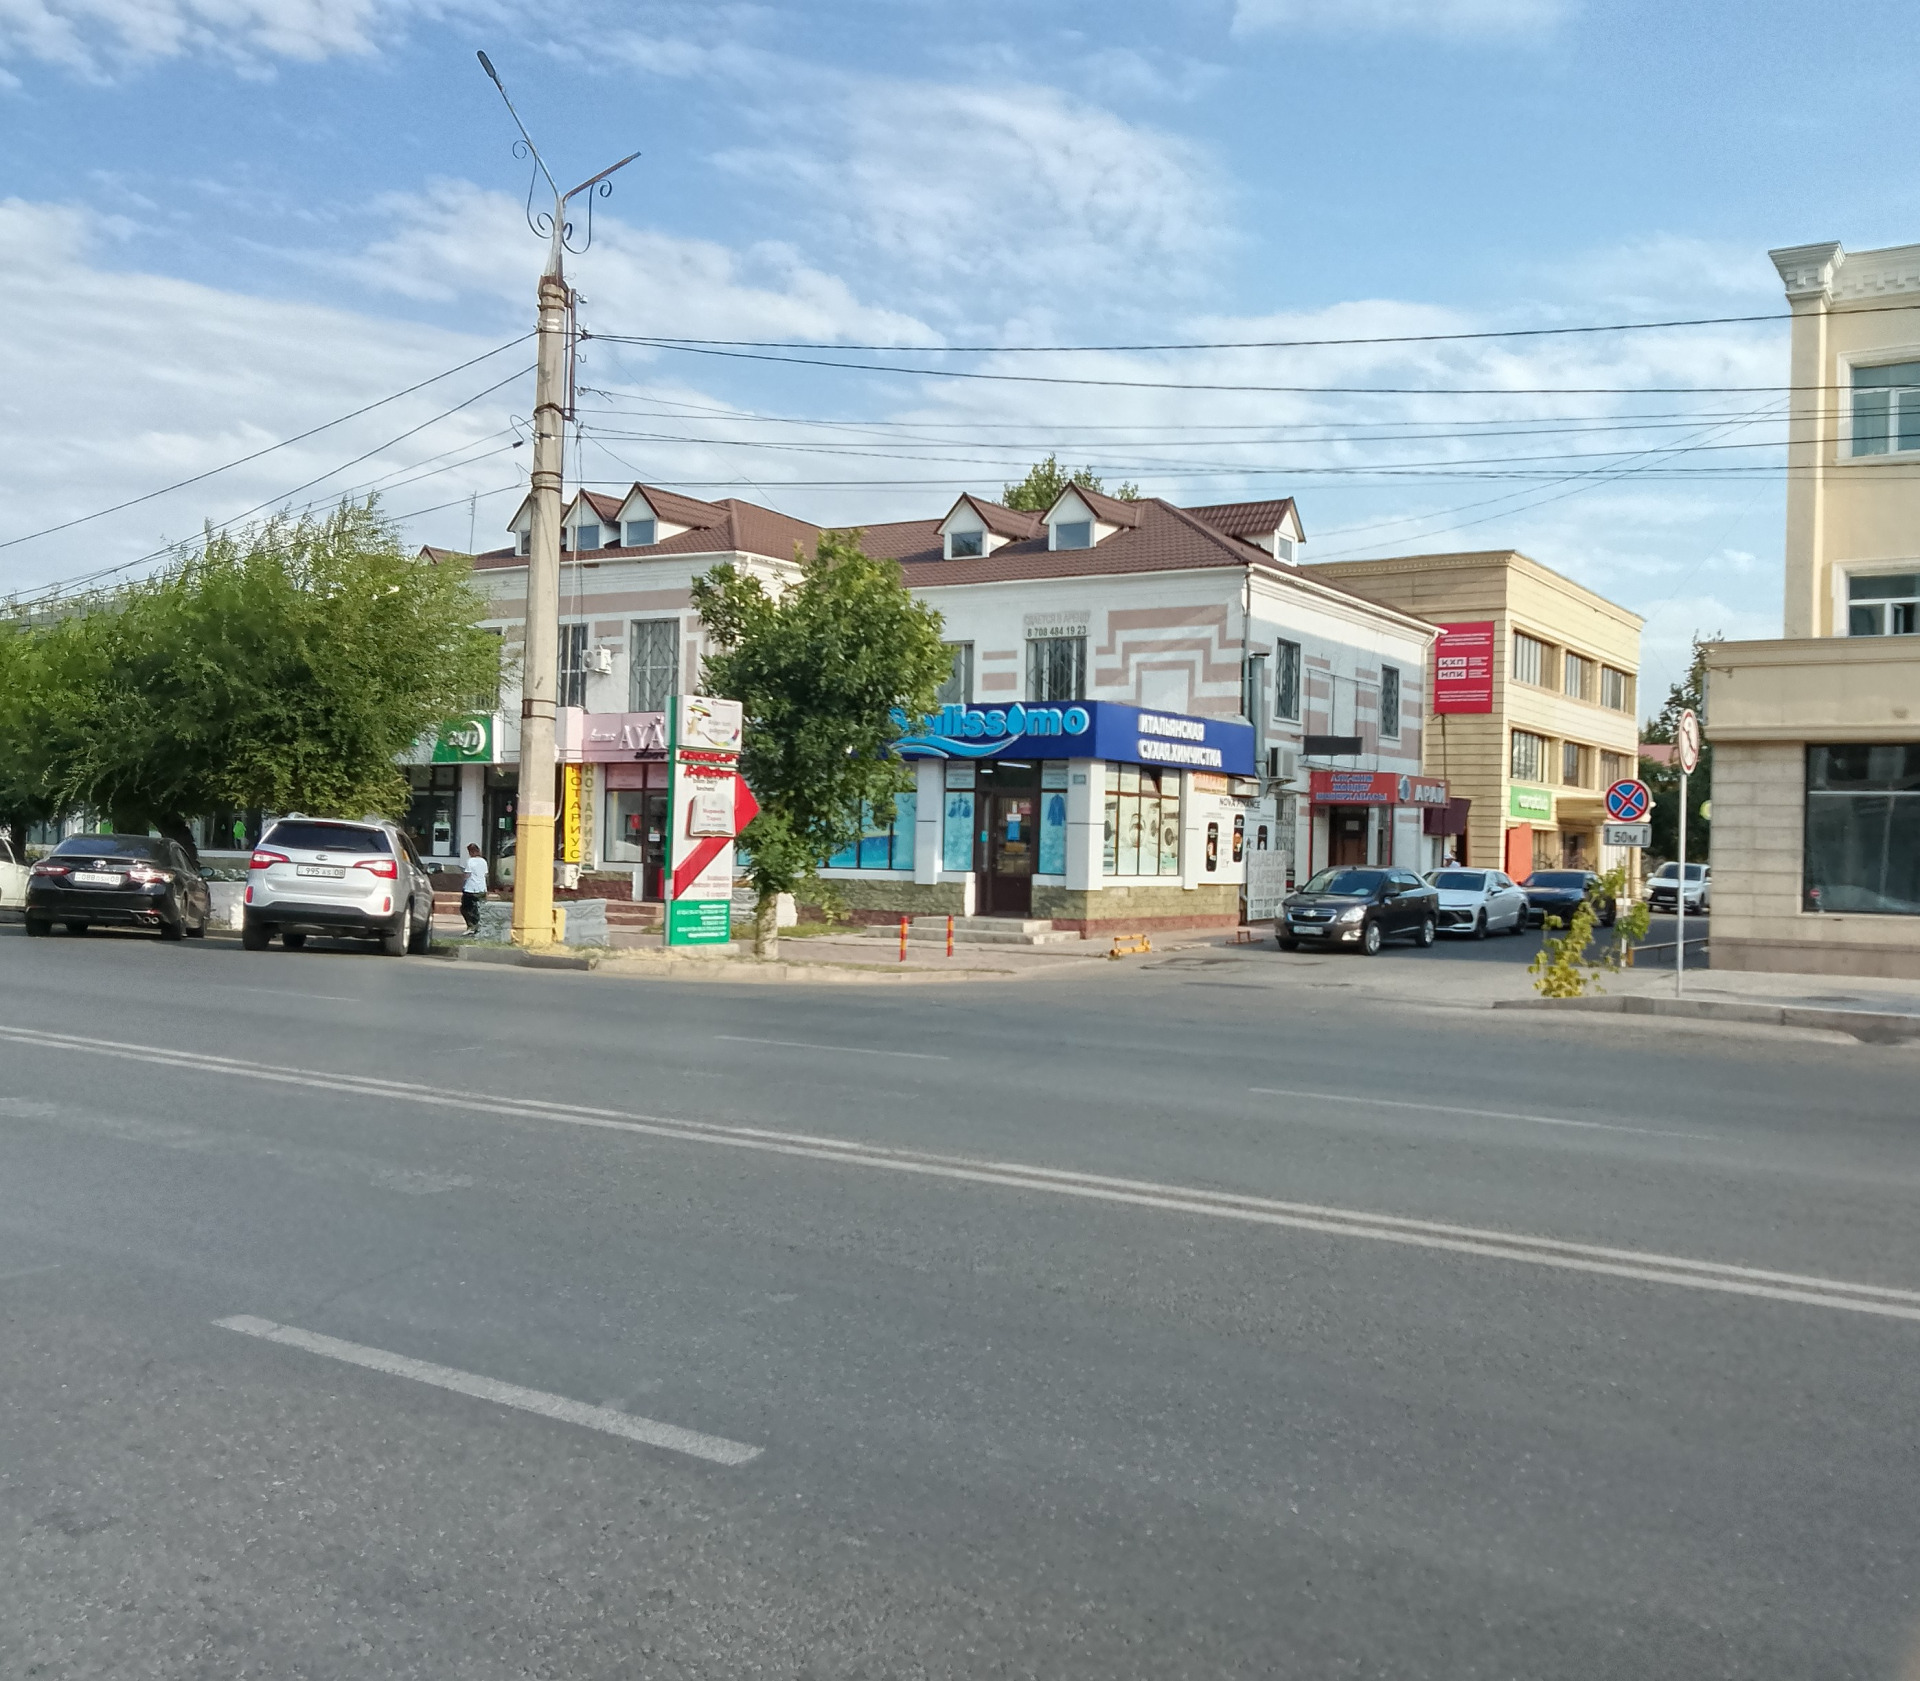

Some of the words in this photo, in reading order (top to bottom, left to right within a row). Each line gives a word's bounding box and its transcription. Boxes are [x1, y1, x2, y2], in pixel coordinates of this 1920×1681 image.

[1049, 626, 1064, 636] 484
[1066, 626, 1075, 635] 19
[1077, 625, 1087, 635] 23
[570, 764, 582, 859] НОТАРИУС
[584, 765, 594, 862] НОТАРИУС
[305, 867, 320, 876] 995
[334, 868, 344, 876] 08
